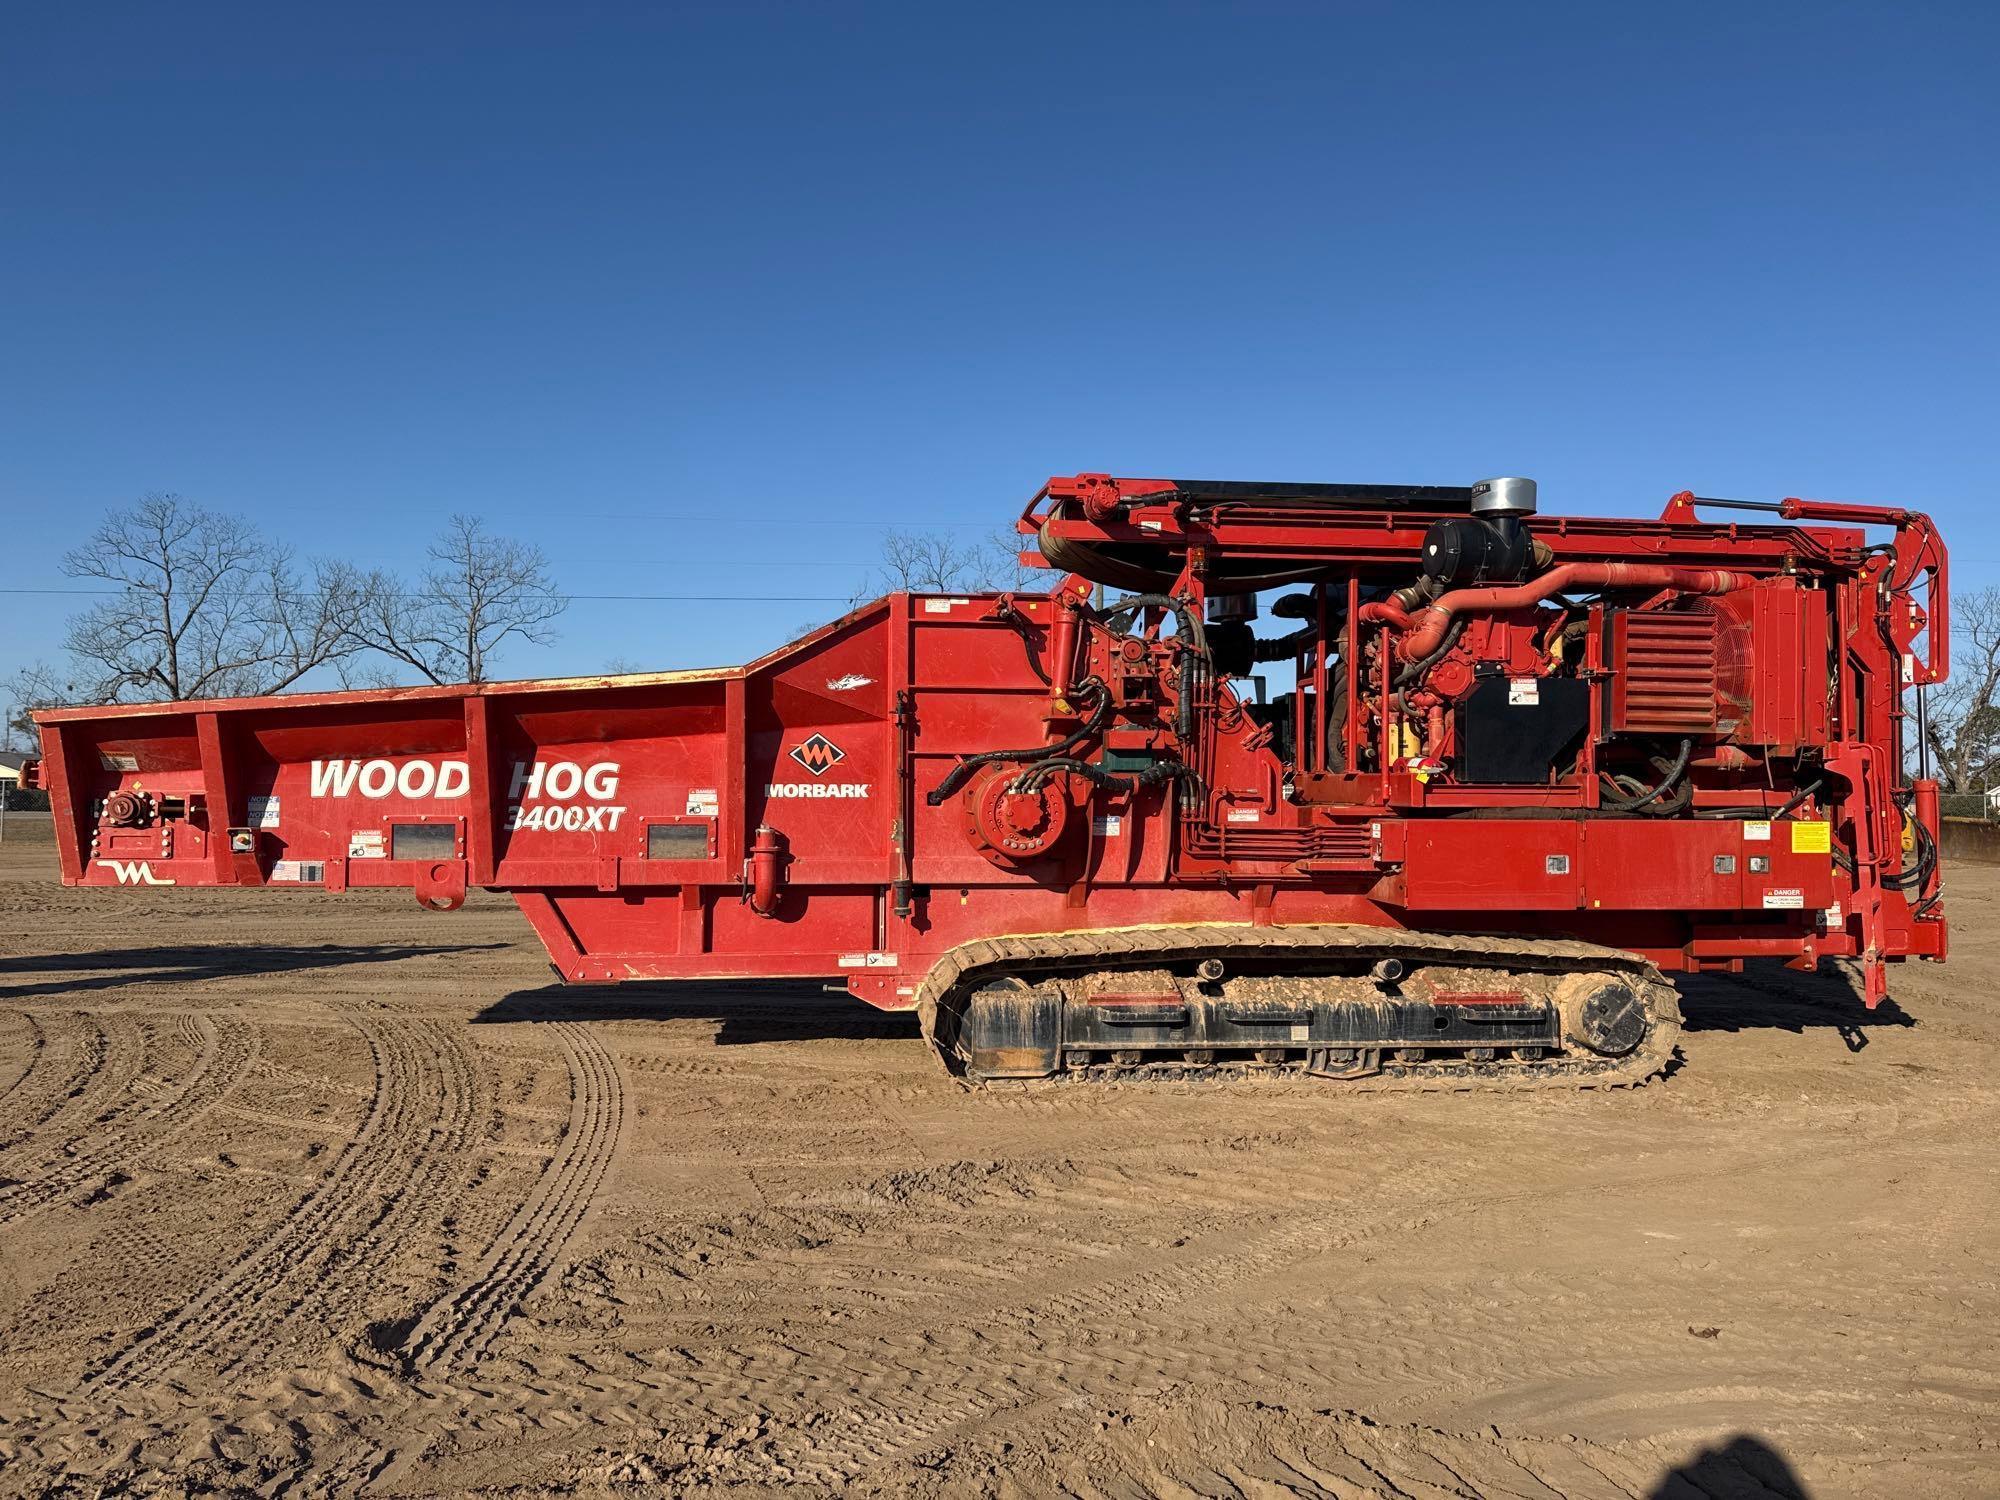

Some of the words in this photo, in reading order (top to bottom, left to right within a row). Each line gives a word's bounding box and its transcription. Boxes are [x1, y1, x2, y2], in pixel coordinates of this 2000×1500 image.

[310, 759, 471, 799] WOOD
[507, 761, 620, 800] HOG
[764, 783, 869, 798] MORBARK
[504, 805, 627, 831] 3400XT
